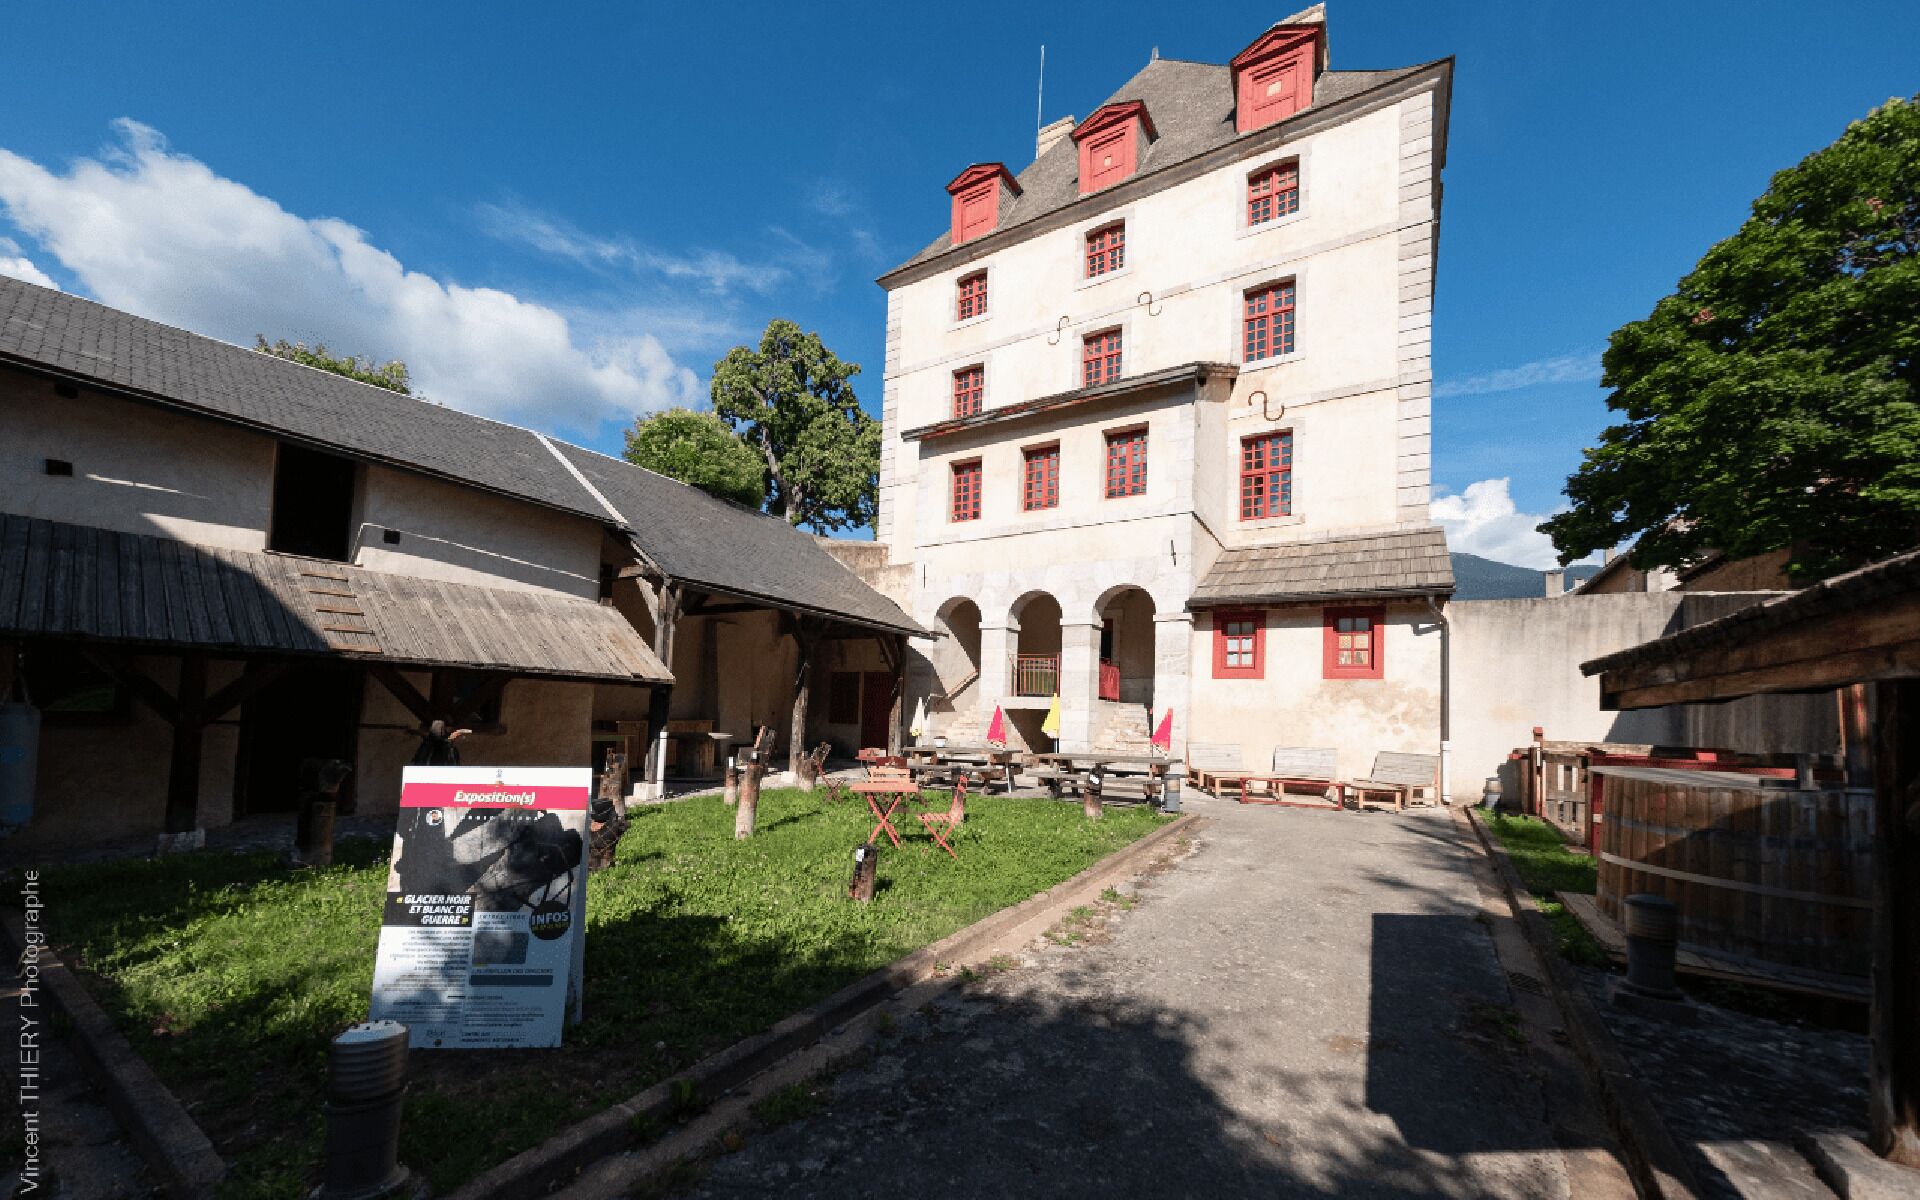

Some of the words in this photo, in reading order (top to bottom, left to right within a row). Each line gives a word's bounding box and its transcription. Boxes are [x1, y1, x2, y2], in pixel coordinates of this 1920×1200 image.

[454, 790, 536, 805] Exposition(s)
[405, 895, 444, 904] GLACIER
[445, 895, 472, 904] NOIR
[409, 905, 422, 914] ET
[423, 905, 454, 914] BLANC
[455, 905, 471, 914] DE
[421, 915, 460, 925] GUERRE
[531, 912, 569, 925] INFOS
